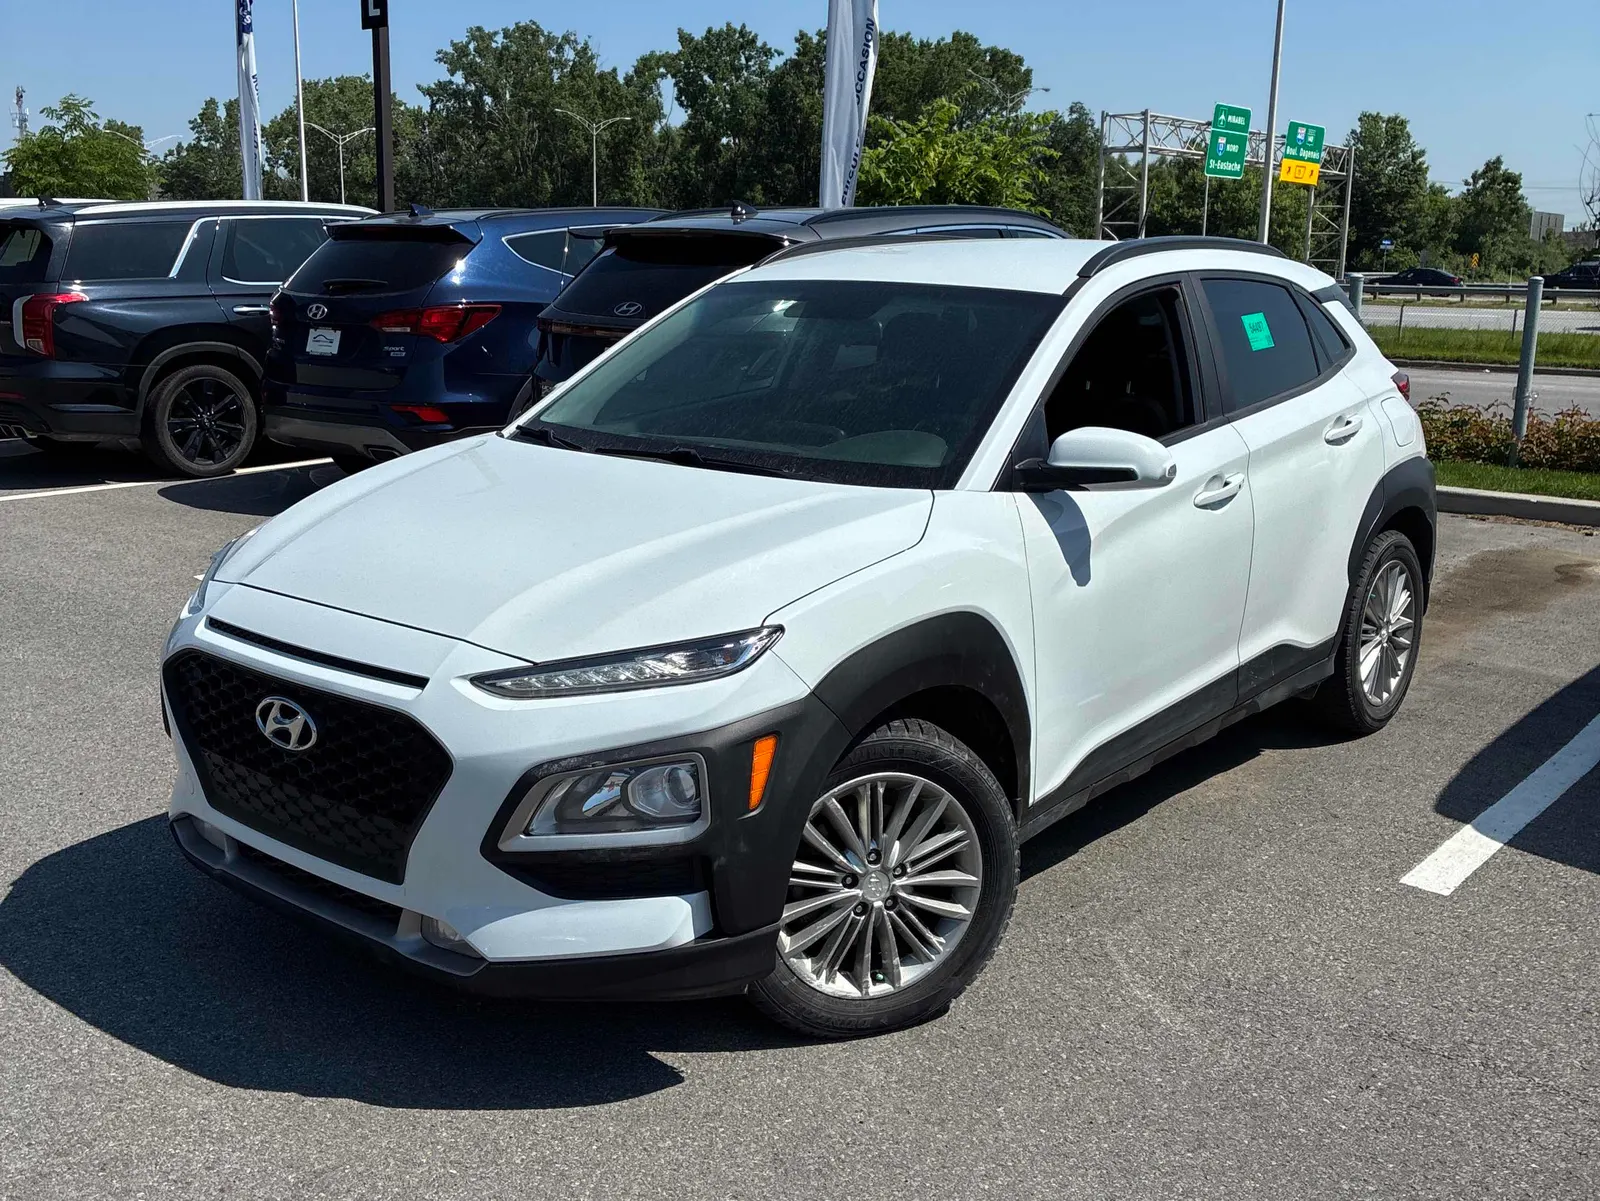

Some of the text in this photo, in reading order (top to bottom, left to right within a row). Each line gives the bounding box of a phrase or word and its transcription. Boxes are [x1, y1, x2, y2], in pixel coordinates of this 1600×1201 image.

[1228, 115, 1246, 126] MIRABEL
[1226, 143, 1240, 153] NORD
[1286, 145, 1320, 160] Boul. Dagenais
[1209, 158, 1241, 172] St-Eustache
